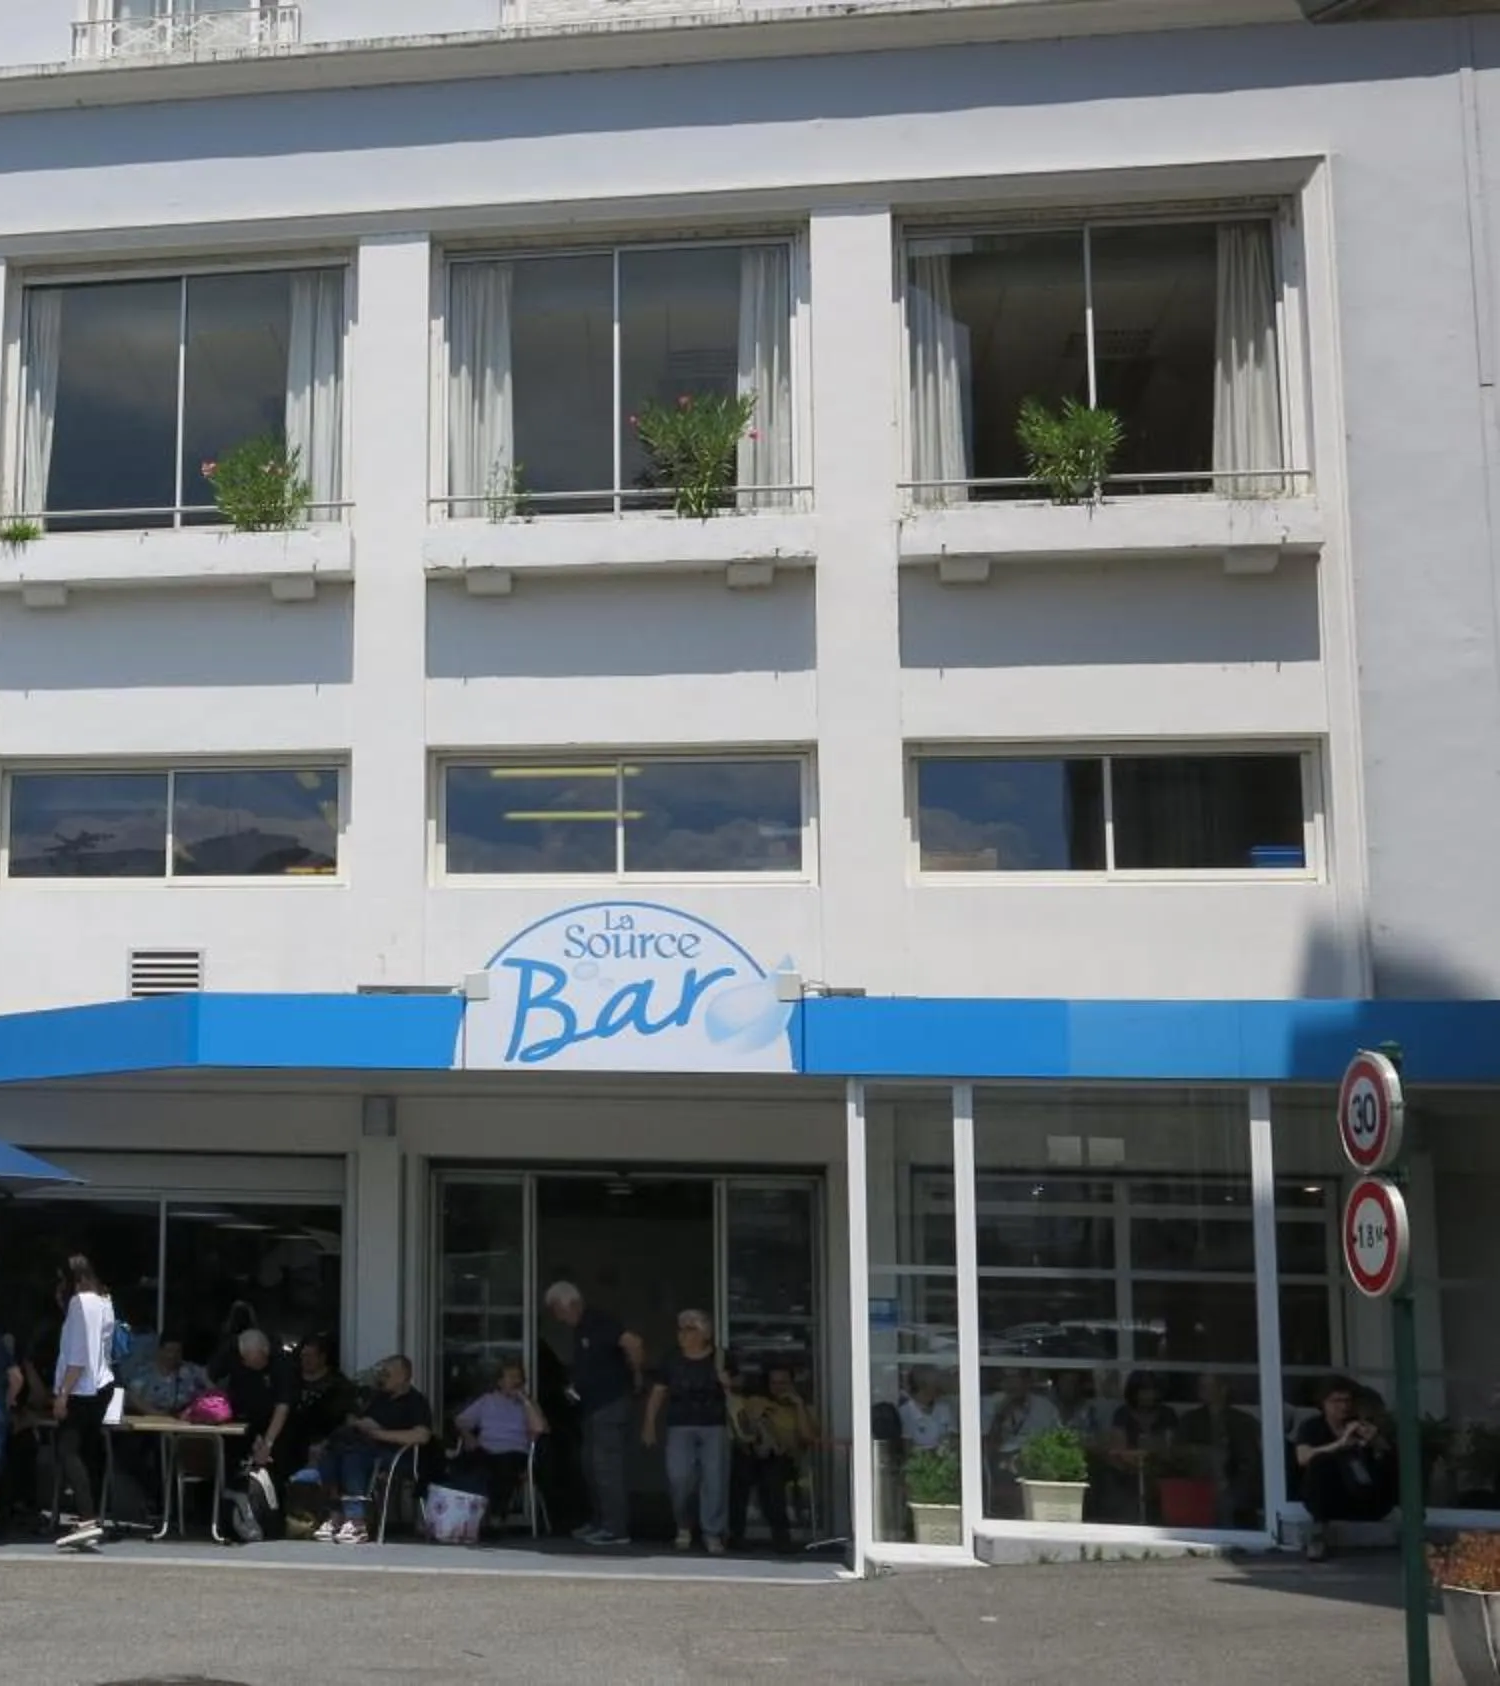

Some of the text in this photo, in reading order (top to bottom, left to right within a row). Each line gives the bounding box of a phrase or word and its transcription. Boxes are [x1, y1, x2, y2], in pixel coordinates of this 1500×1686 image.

[604, 910, 635, 932] La
[563, 924, 702, 960] Source
[501, 957, 737, 1063] Bar
[1352, 1093, 1377, 1135] 30
